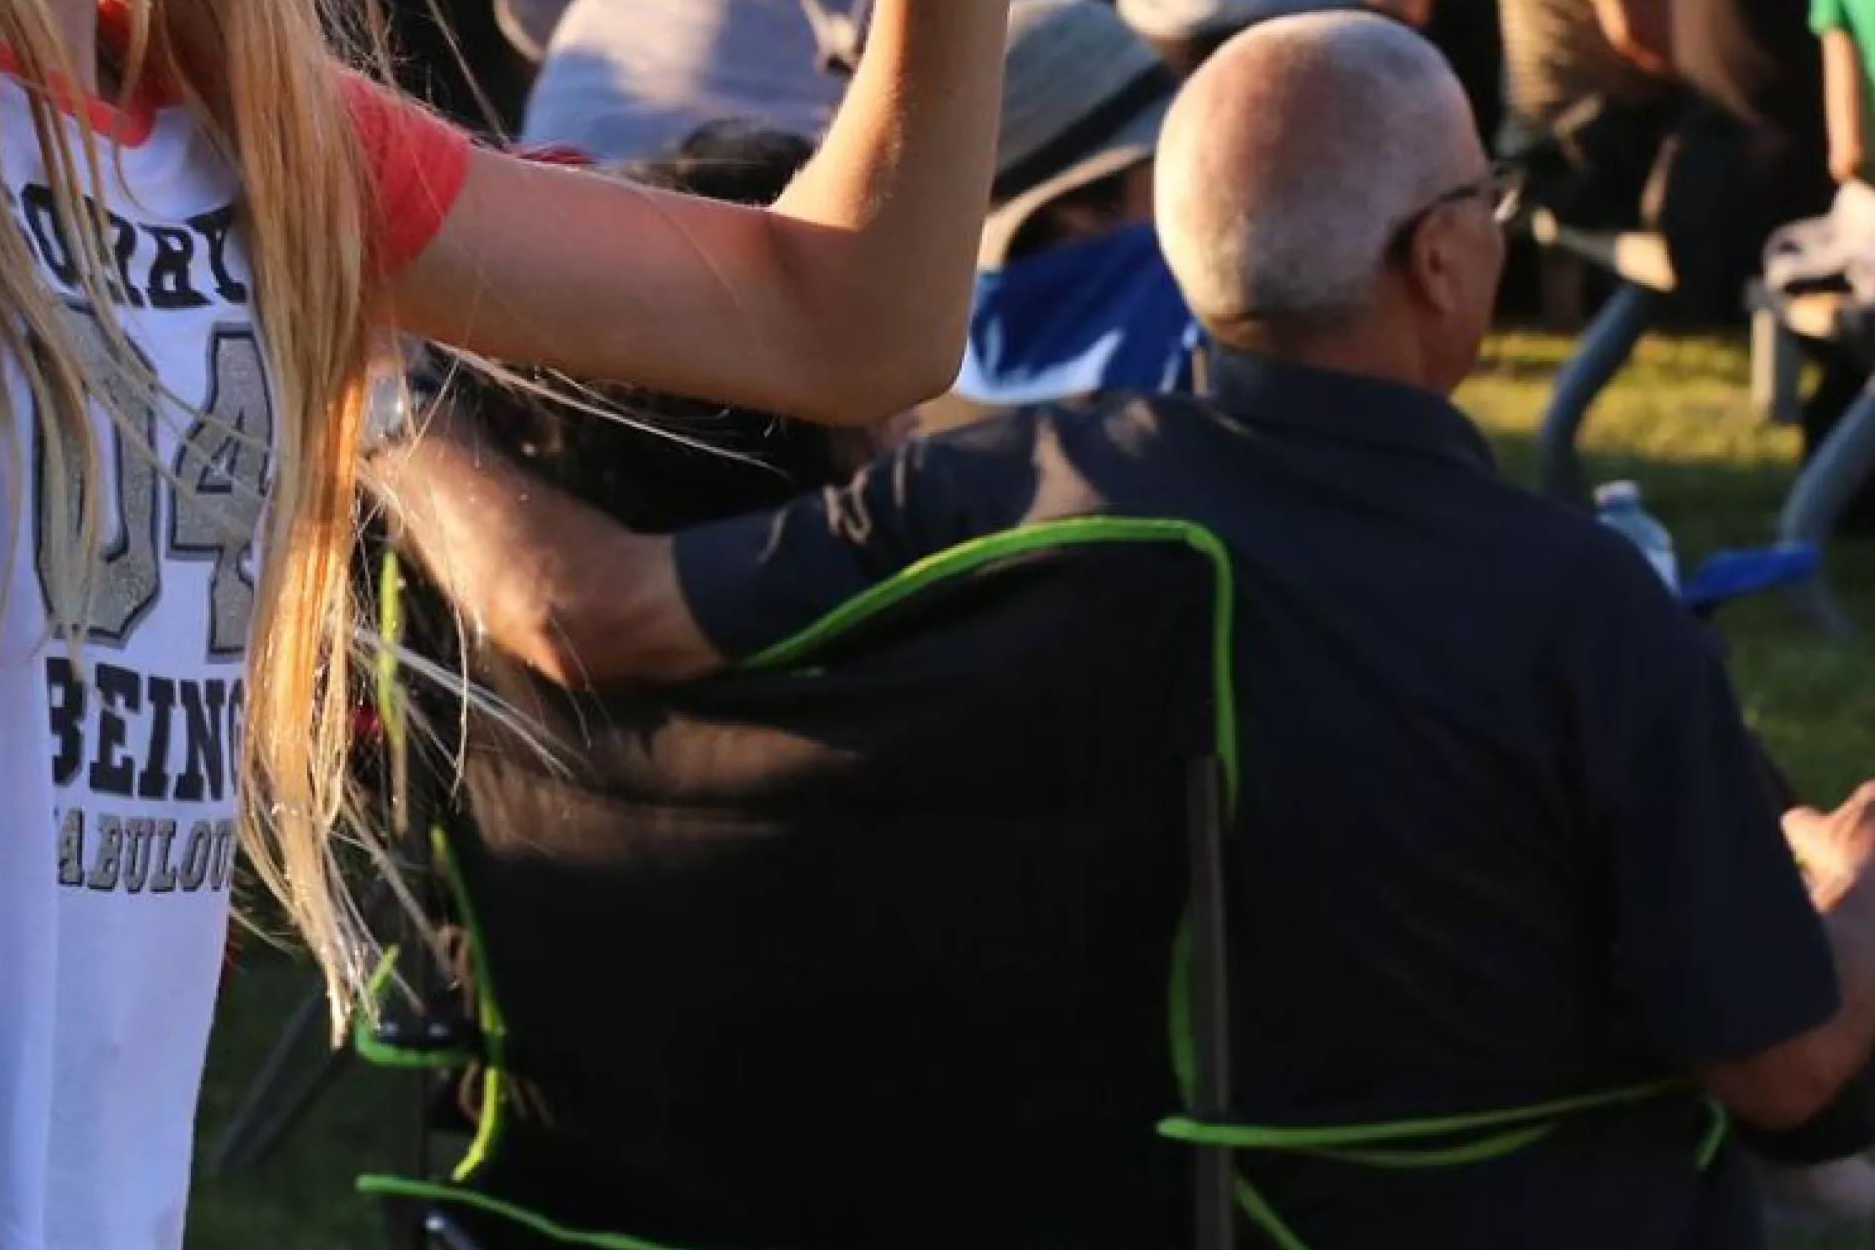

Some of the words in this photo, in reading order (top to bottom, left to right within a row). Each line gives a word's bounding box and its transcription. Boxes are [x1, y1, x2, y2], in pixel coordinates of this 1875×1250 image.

[7, 182, 249, 309] ORRY
[32, 293, 275, 662] 04
[53, 805, 235, 894] ABULOU
